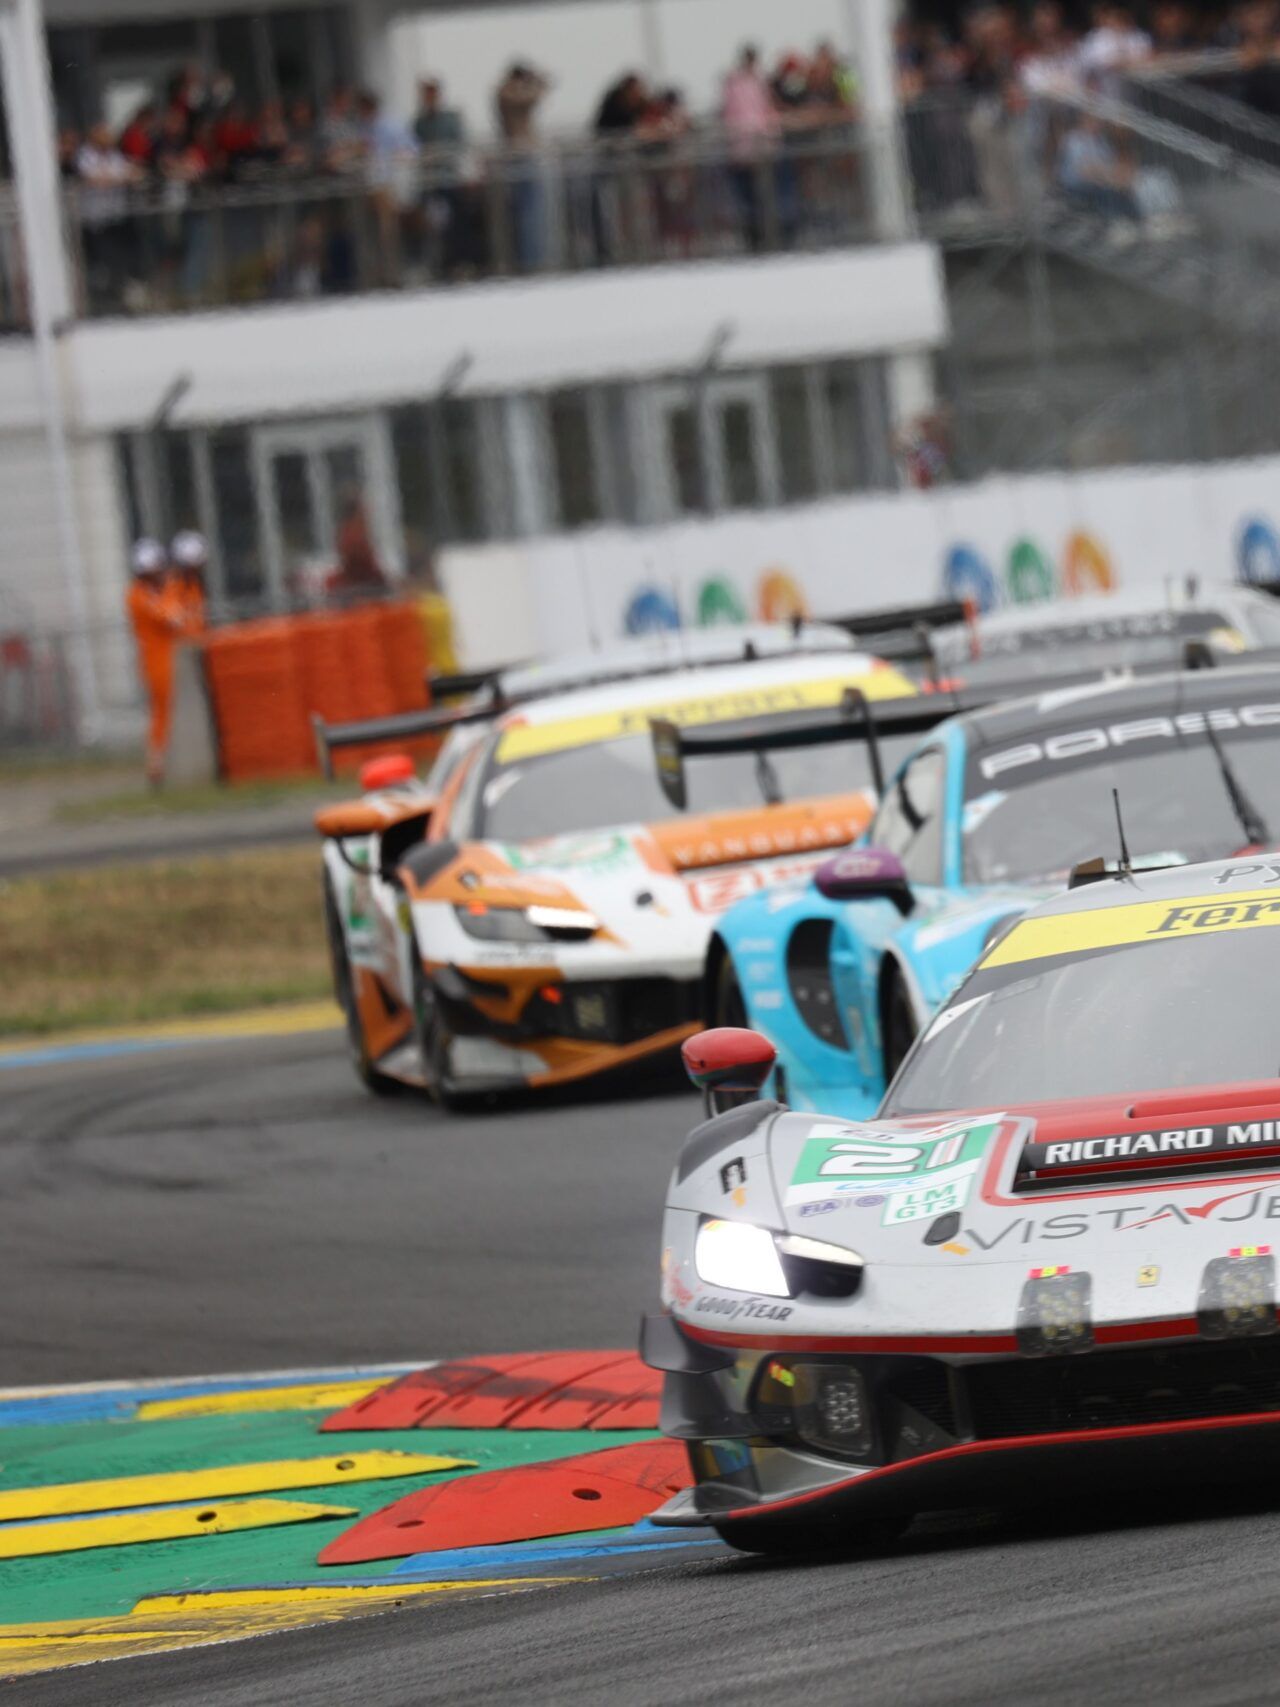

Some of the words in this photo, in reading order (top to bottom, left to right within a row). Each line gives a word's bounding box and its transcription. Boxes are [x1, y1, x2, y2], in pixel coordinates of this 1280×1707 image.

[816, 1130, 971, 1177] 21
[1044, 1127, 1213, 1165] RICHARD
[904, 1183, 955, 1206] LM
[801, 1201, 839, 1216] FIA
[895, 1196, 957, 1219] GT3
